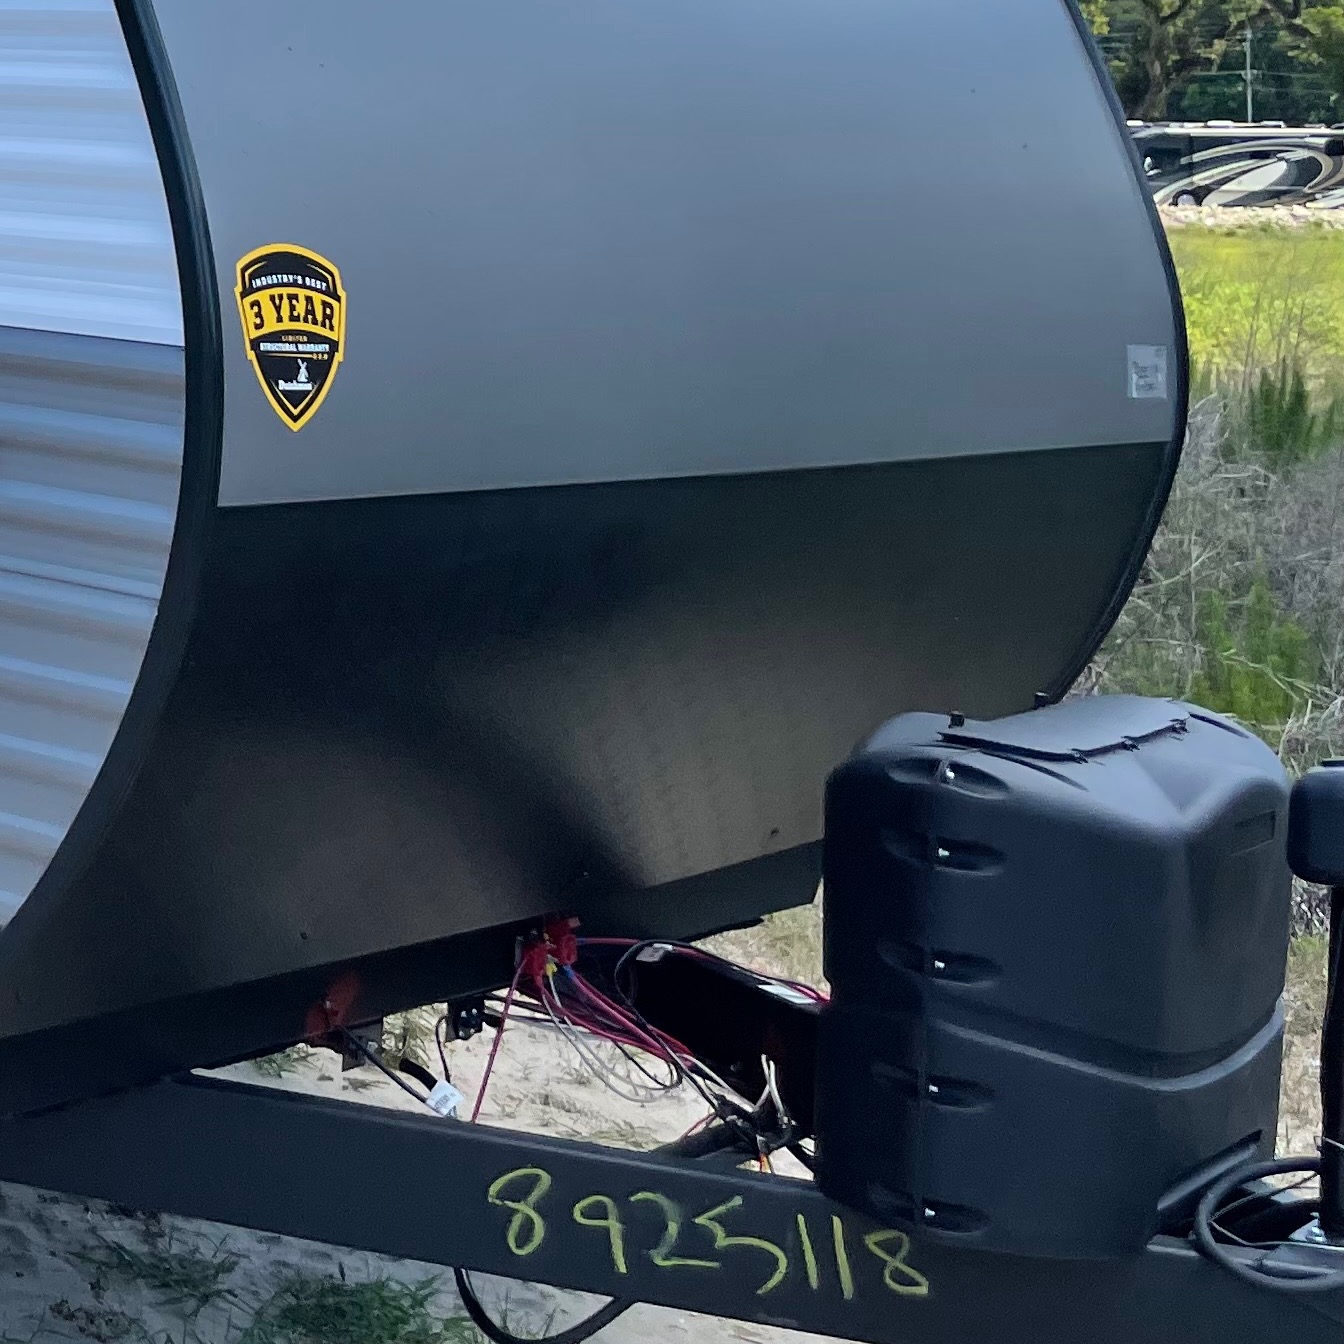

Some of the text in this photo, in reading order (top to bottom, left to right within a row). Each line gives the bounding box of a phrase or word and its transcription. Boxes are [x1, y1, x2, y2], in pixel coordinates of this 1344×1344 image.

[249, 293, 334, 332] 3 YEAR
[486, 1166, 930, 1301] 8925118
